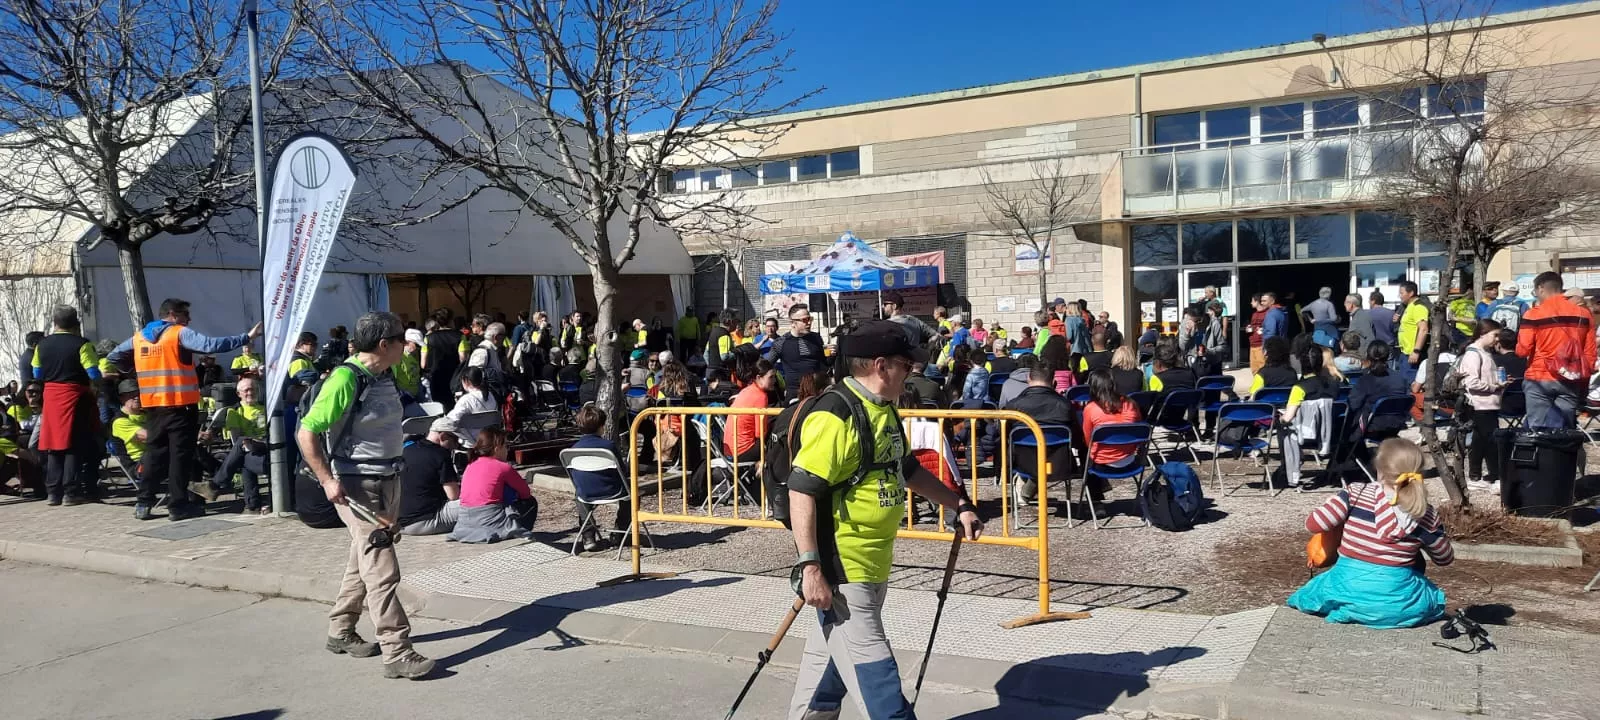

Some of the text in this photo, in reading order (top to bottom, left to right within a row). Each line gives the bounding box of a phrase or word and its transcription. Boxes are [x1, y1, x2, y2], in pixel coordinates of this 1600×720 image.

[271, 213, 307, 306] Venta de aceite de Oliva
[275, 294, 290, 320] Virgen
[286, 283, 294, 294] de
[306, 211, 318, 238] propia
[306, 200, 333, 272] COOPERATIVA
[313, 239, 329, 276] SANTA
[326, 189, 347, 235] LETICIA
[878, 491, 889, 499] EN
[879, 499, 893, 508] DEL
